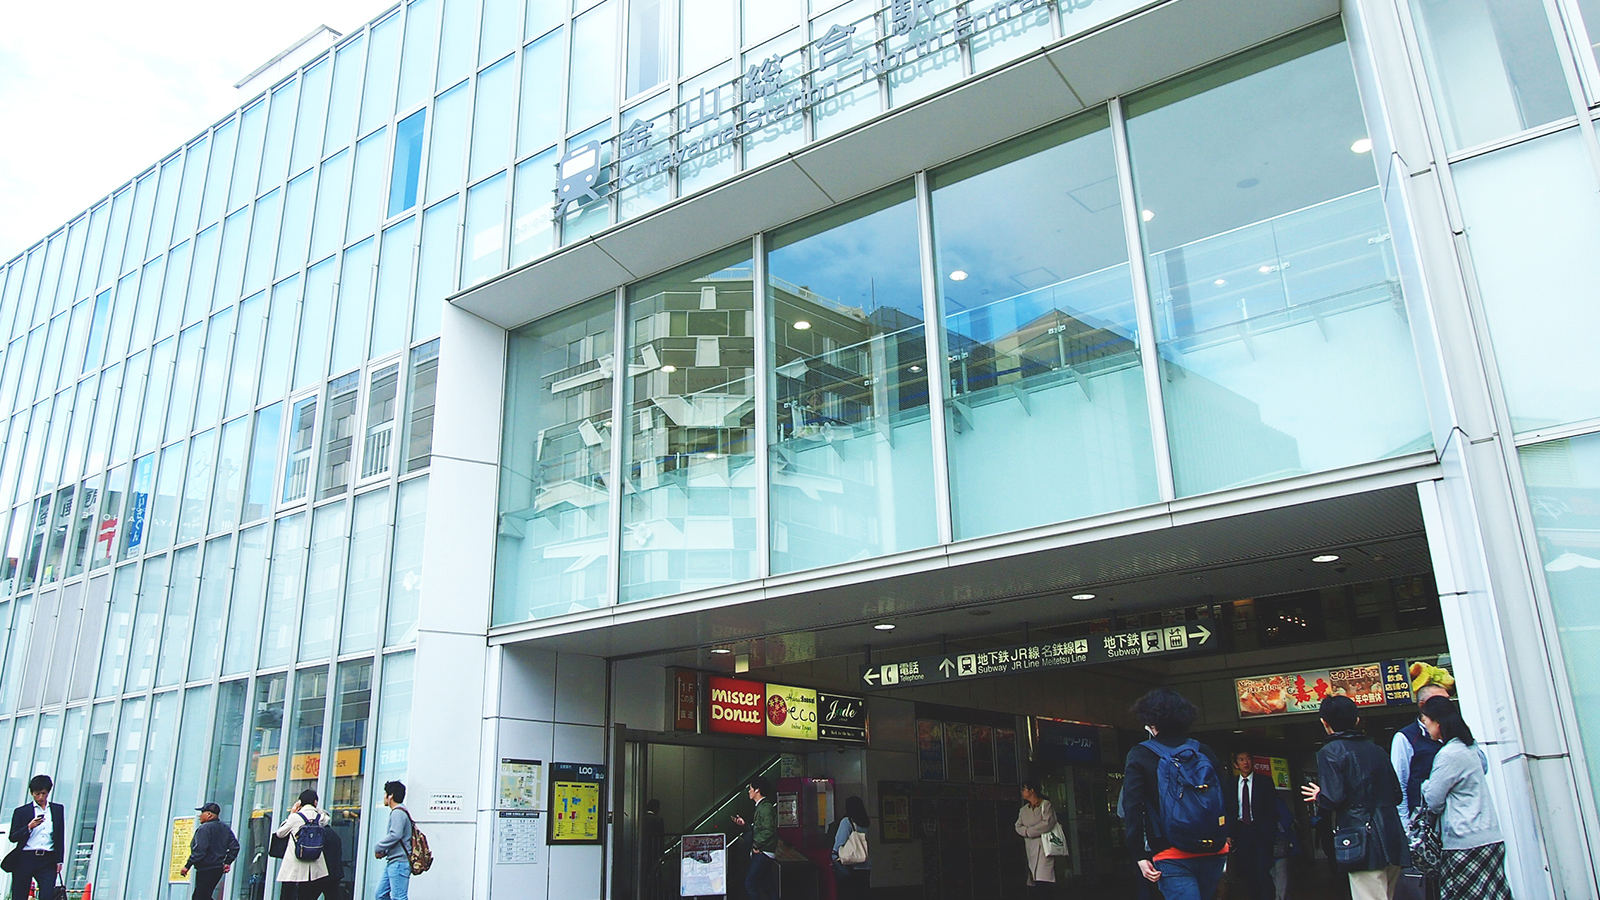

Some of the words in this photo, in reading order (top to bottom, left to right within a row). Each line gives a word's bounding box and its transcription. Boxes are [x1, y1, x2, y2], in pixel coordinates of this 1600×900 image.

[619, 0, 937, 161] 金山総合駅
[619, 124, 739, 187] Kanayama
[744, 78, 838, 131] Station
[862, 32, 943, 82] North
[953, 0, 1046, 41] Entra
[1103, 633, 1140, 649] 地下鉄
[977, 650, 1010, 666] 地下鉄
[1011, 646, 1040, 661] JR線
[1041, 641, 1075, 658] 名鉄線
[1107, 647, 1141, 658] Subway
[899, 661, 919, 675] 電話
[978, 664, 1007, 674] Subway
[1011, 661, 1022, 671] JR
[1023, 659, 1040, 669] Line
[1042, 655, 1070, 667] Meitetsu
[1071, 653, 1087, 663] Line
[1387, 665, 1400, 674] 2F
[900, 673, 925, 683] Telephone
[1387, 674, 1403, 683] 飲食
[681, 683, 694, 692] 1F
[1355, 693, 1383, 704] 年中無休
[1387, 691, 1410, 700] ご案内
[712, 704, 761, 724] Donut
[790, 706, 816, 723] eco
[826, 700, 857, 721] Jade
